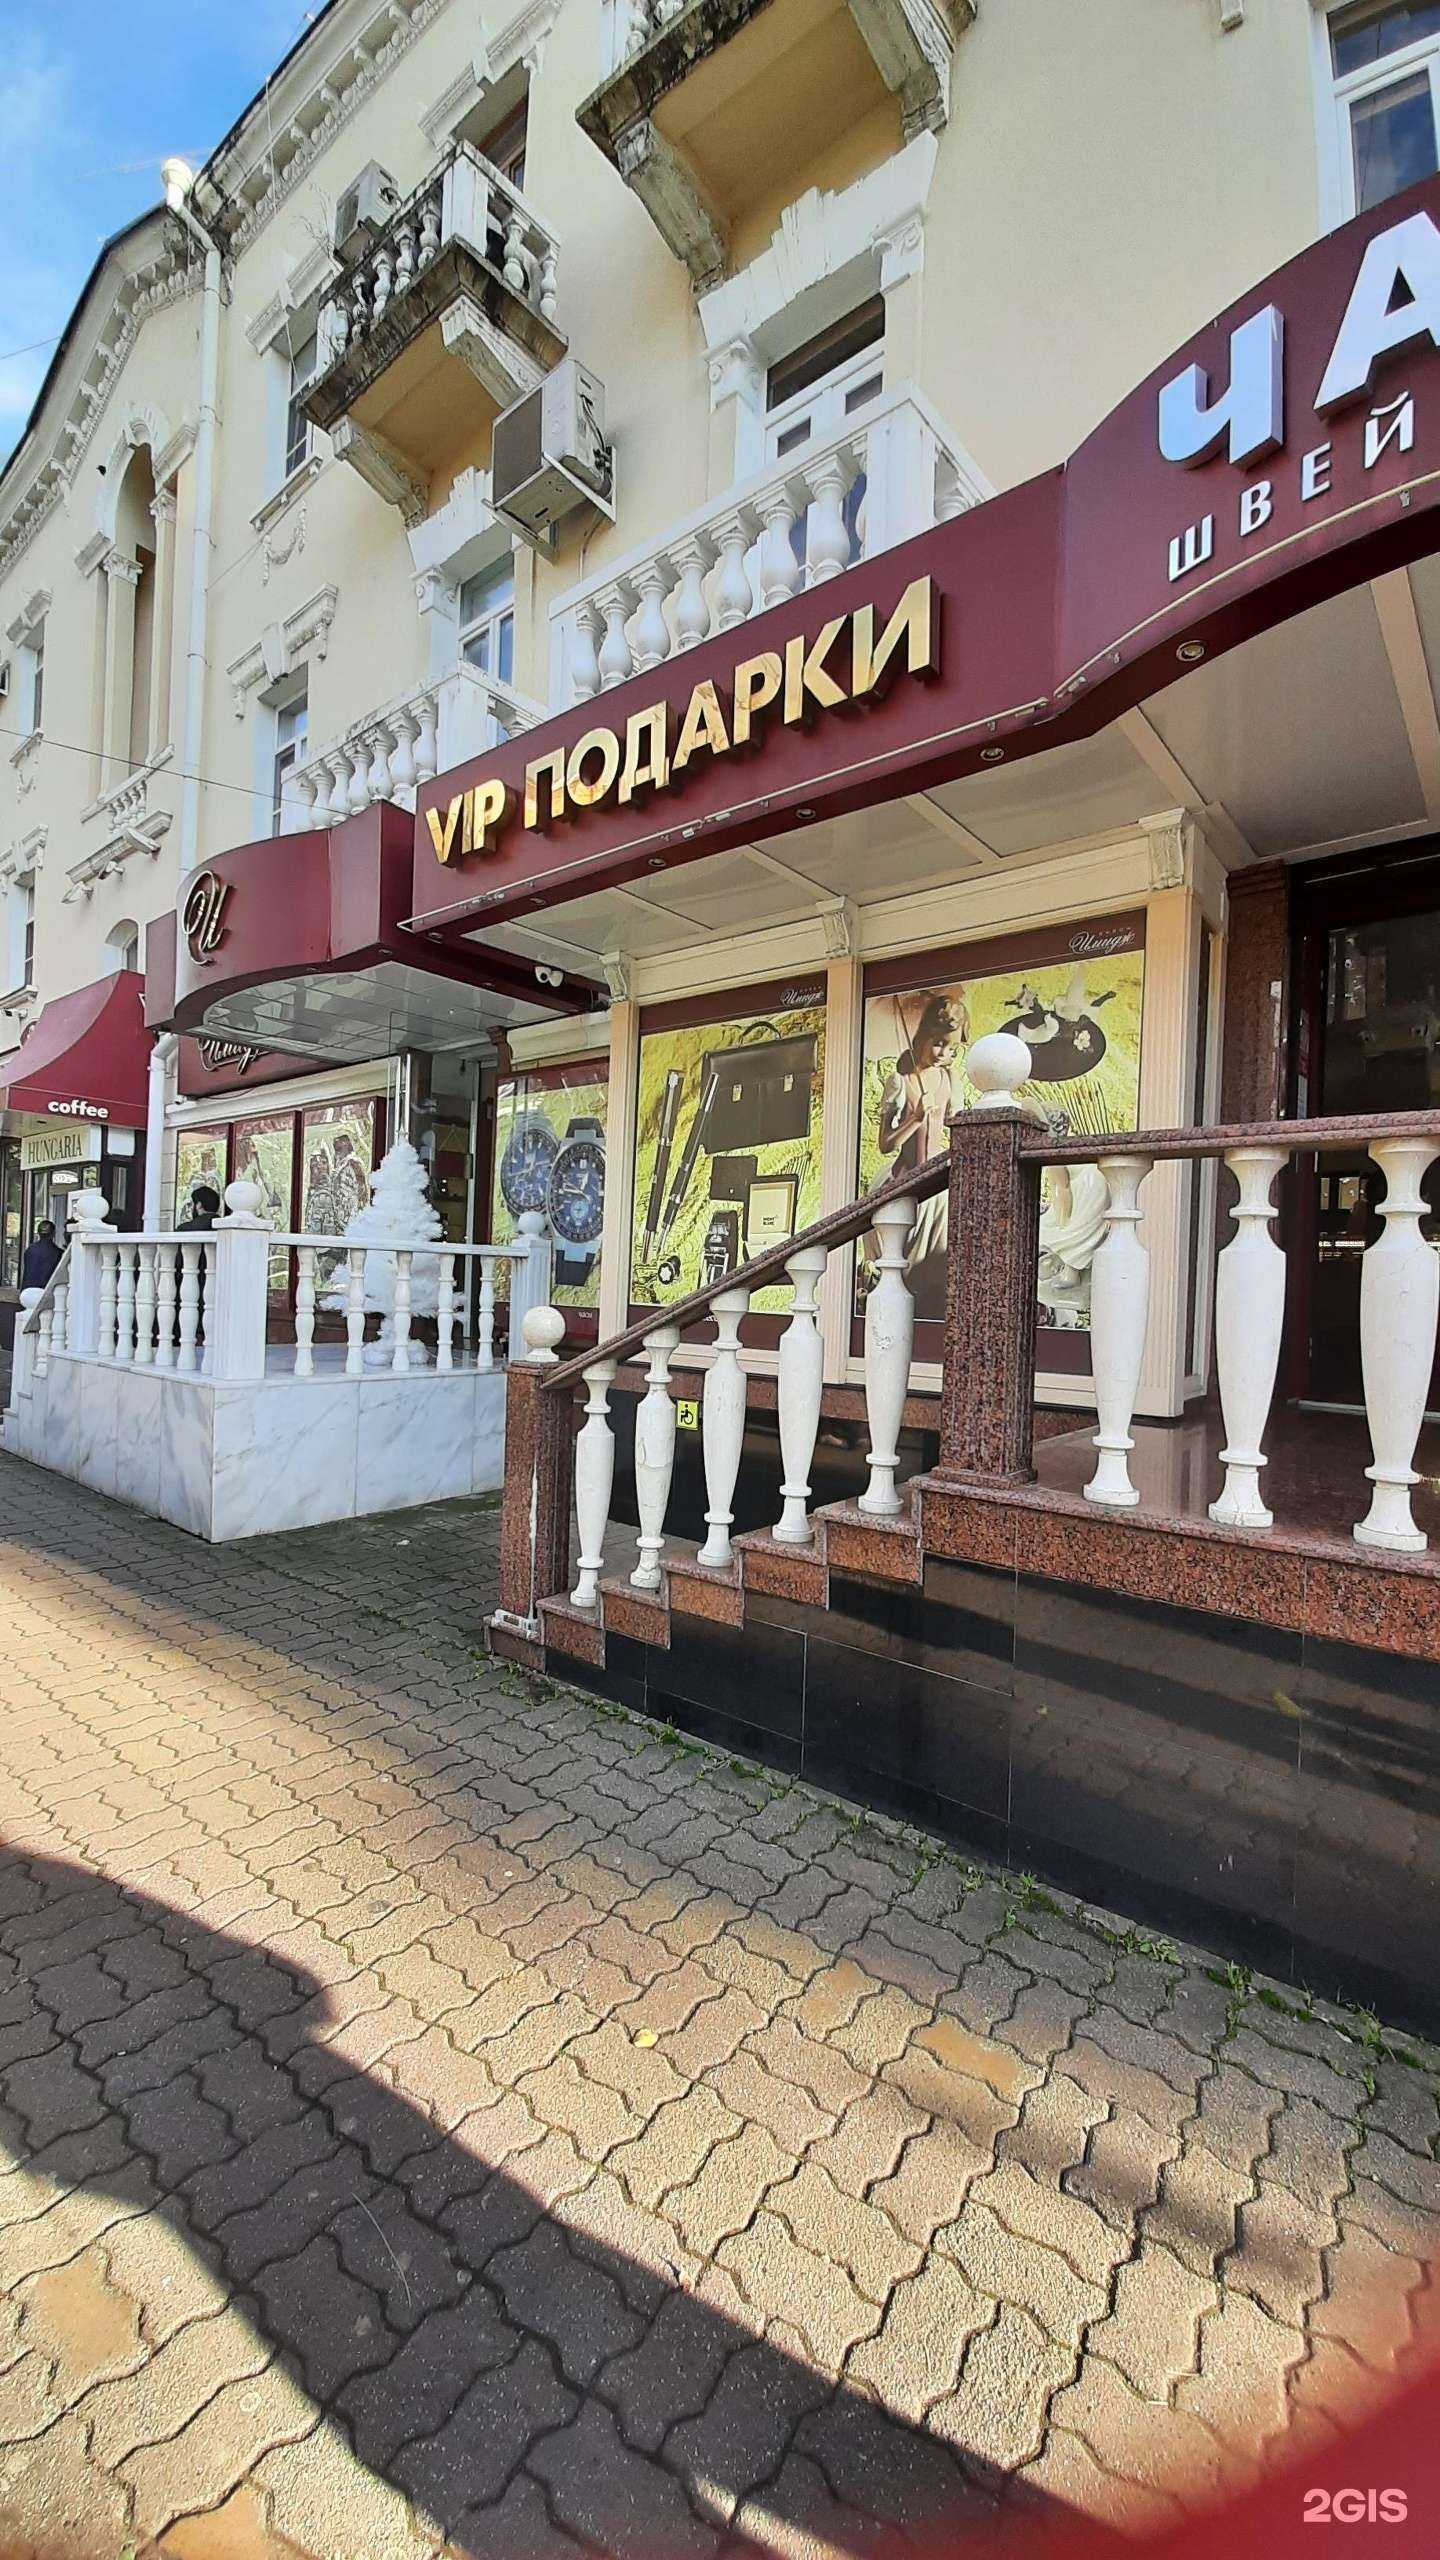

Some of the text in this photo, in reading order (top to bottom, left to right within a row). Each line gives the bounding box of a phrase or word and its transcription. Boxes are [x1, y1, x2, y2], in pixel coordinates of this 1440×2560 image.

[1158, 210, 1440, 467] ЧА
[1168, 390, 1414, 583] ШВЕЙ
[425, 574, 934, 866] VIP ПОДАРКИ
[27, 1134, 83, 1164] HUNGARIA
[48, 1099, 109, 1118] coffee
